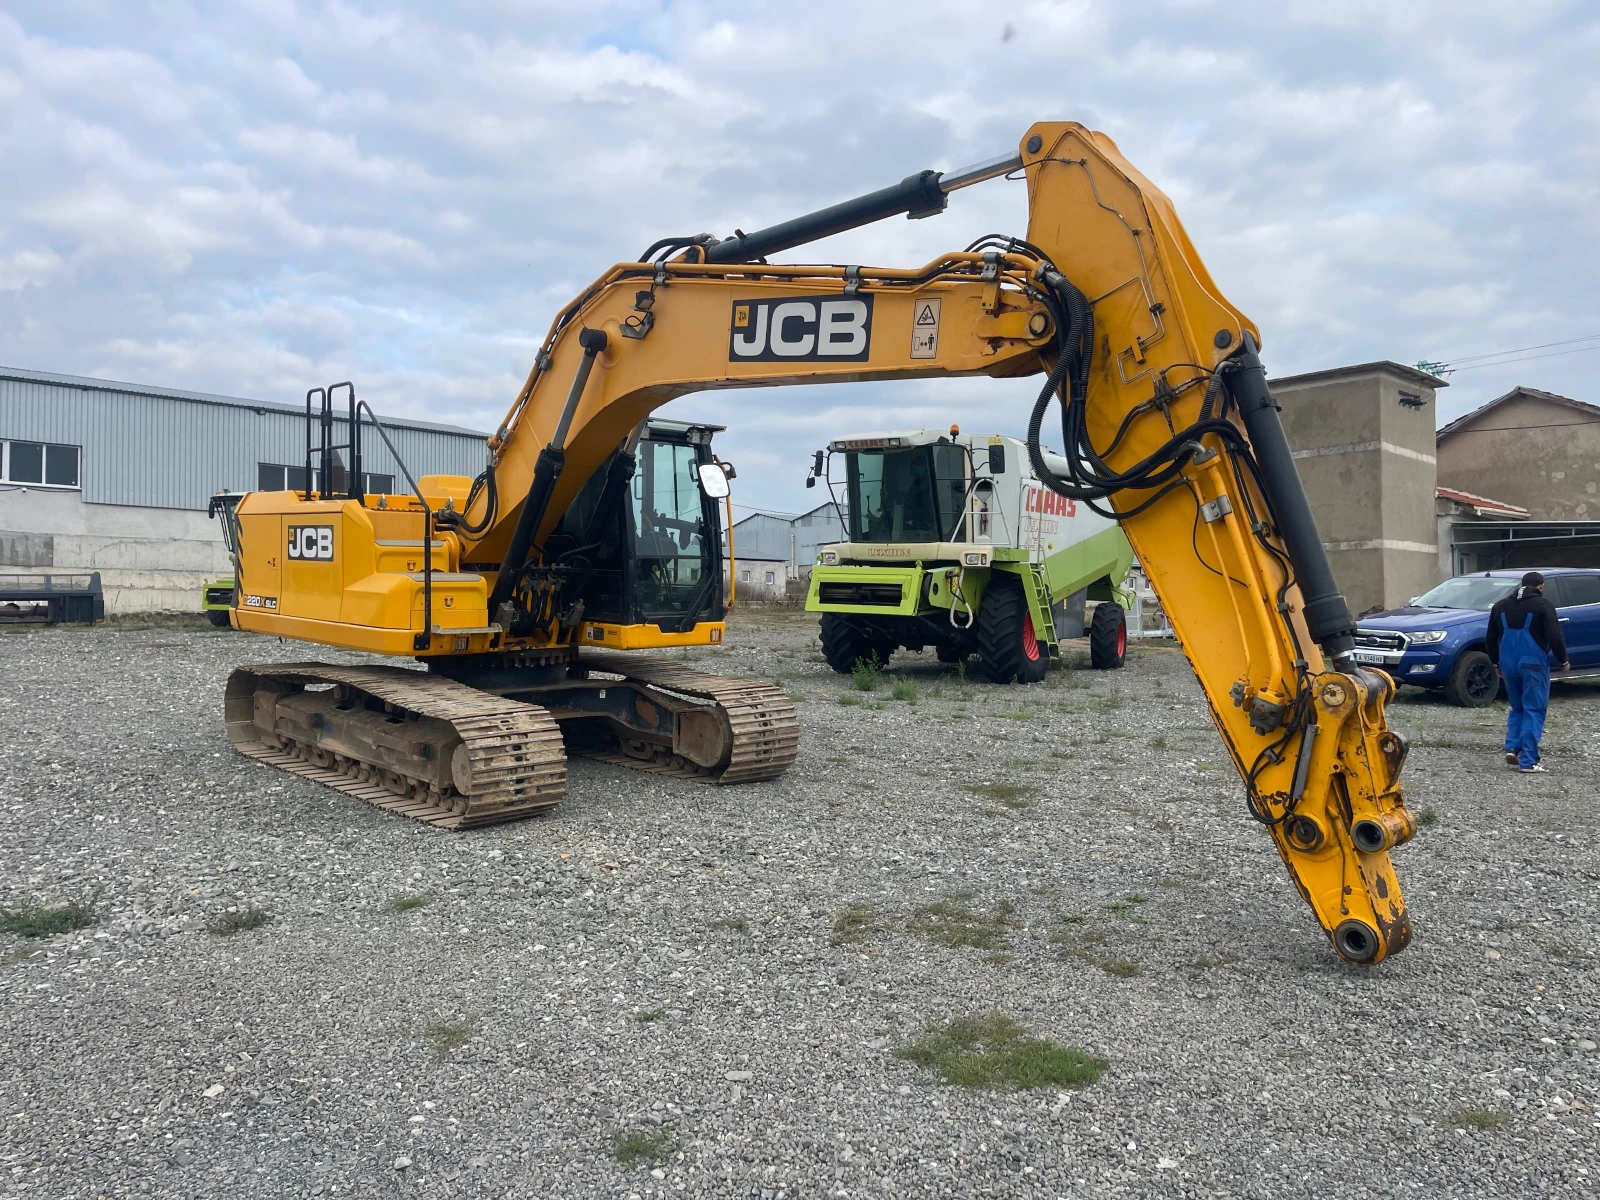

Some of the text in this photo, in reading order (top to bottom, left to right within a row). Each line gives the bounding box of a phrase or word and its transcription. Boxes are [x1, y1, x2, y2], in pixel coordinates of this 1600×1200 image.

[733, 300, 868, 356] JCB
[848, 439, 886, 448] CLAAS
[1025, 488, 1076, 517] CLAAS
[289, 528, 333, 558] JCB
[868, 548, 911, 558] LEXION
[265, 599, 277, 608] SLC
